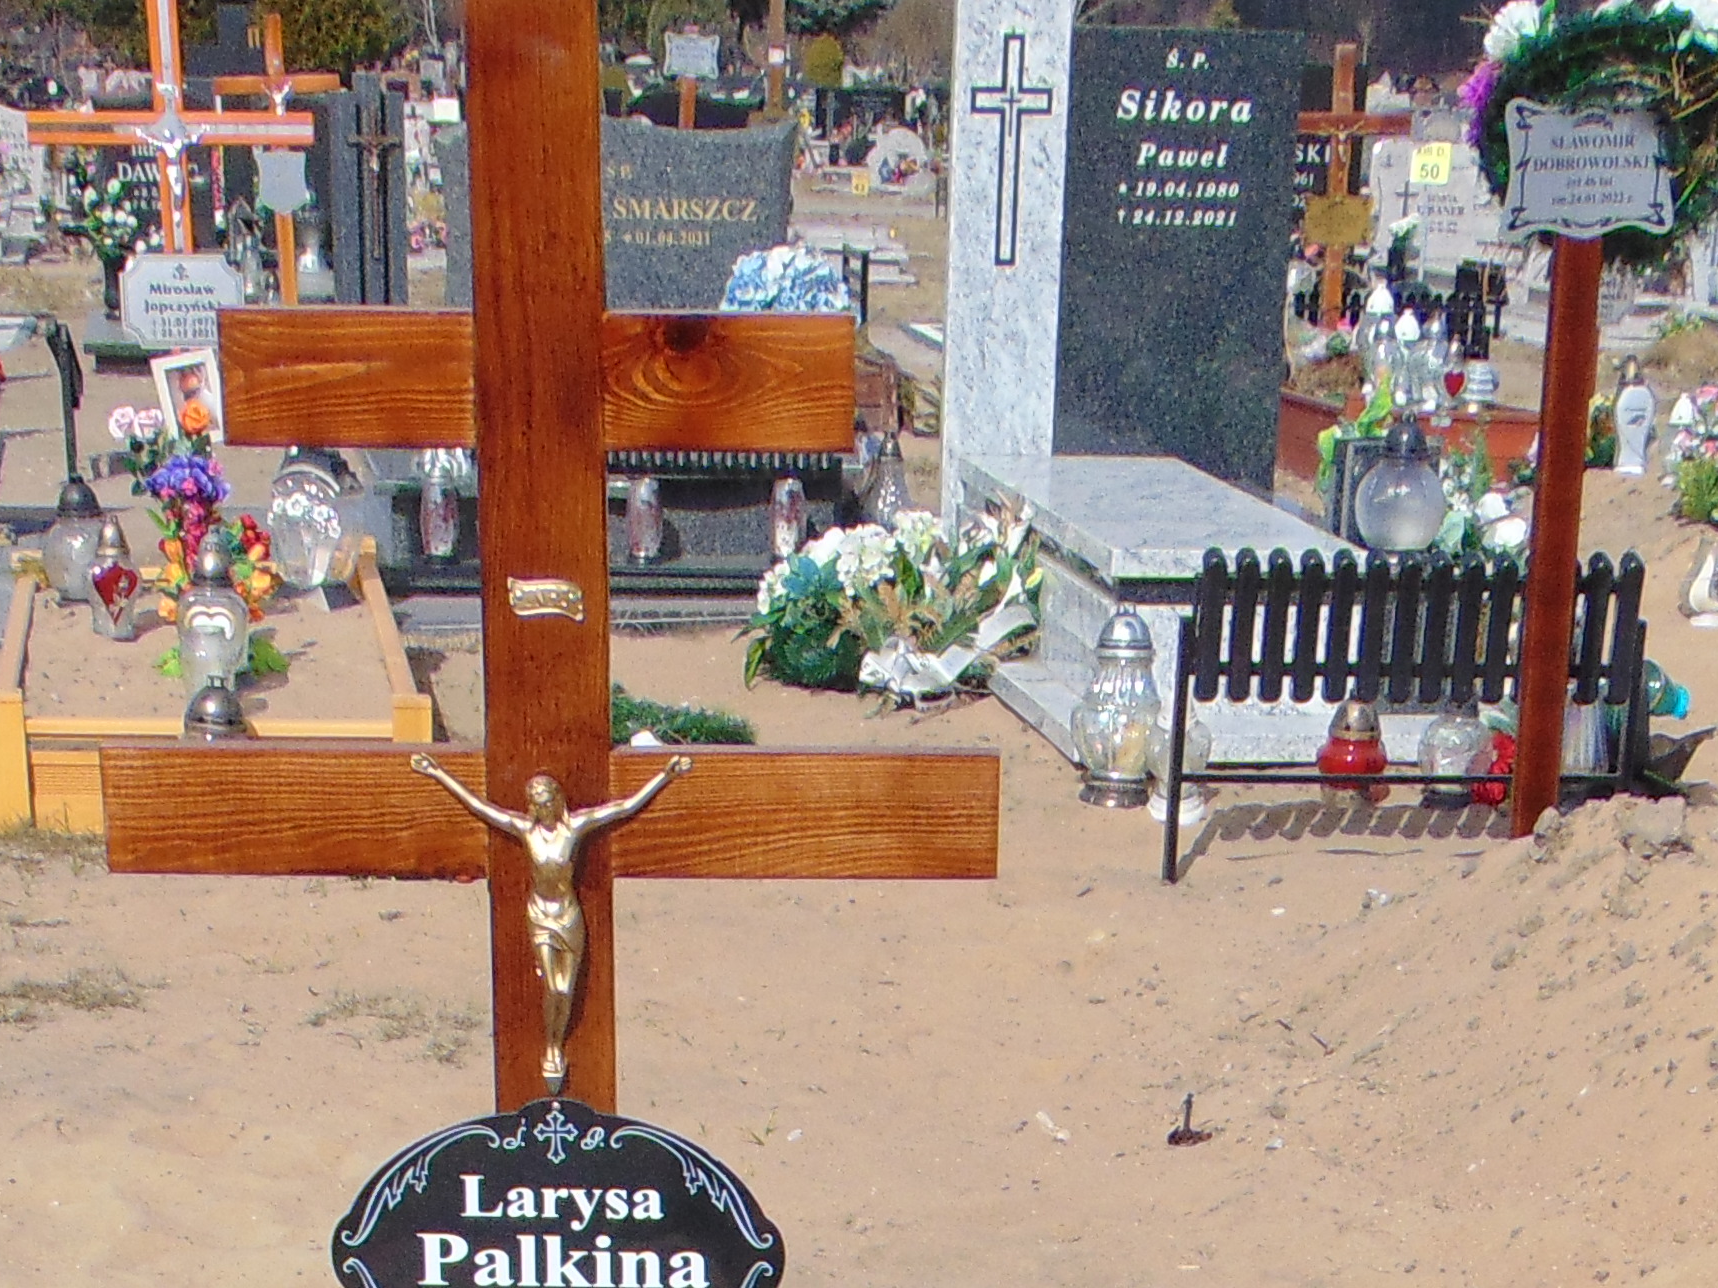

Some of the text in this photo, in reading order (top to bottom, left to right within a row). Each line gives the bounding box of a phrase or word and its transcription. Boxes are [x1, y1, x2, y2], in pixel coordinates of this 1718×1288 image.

[1117, 88, 1252, 122] Sikora
[1421, 162, 1441, 179] 50
[1533, 155, 1649, 172] DOBROWOLSKI
[1136, 180, 1240, 198] 19.04.1980
[1133, 207, 1238, 226] 24.12.2021
[458, 1173, 666, 1232] Larysa
